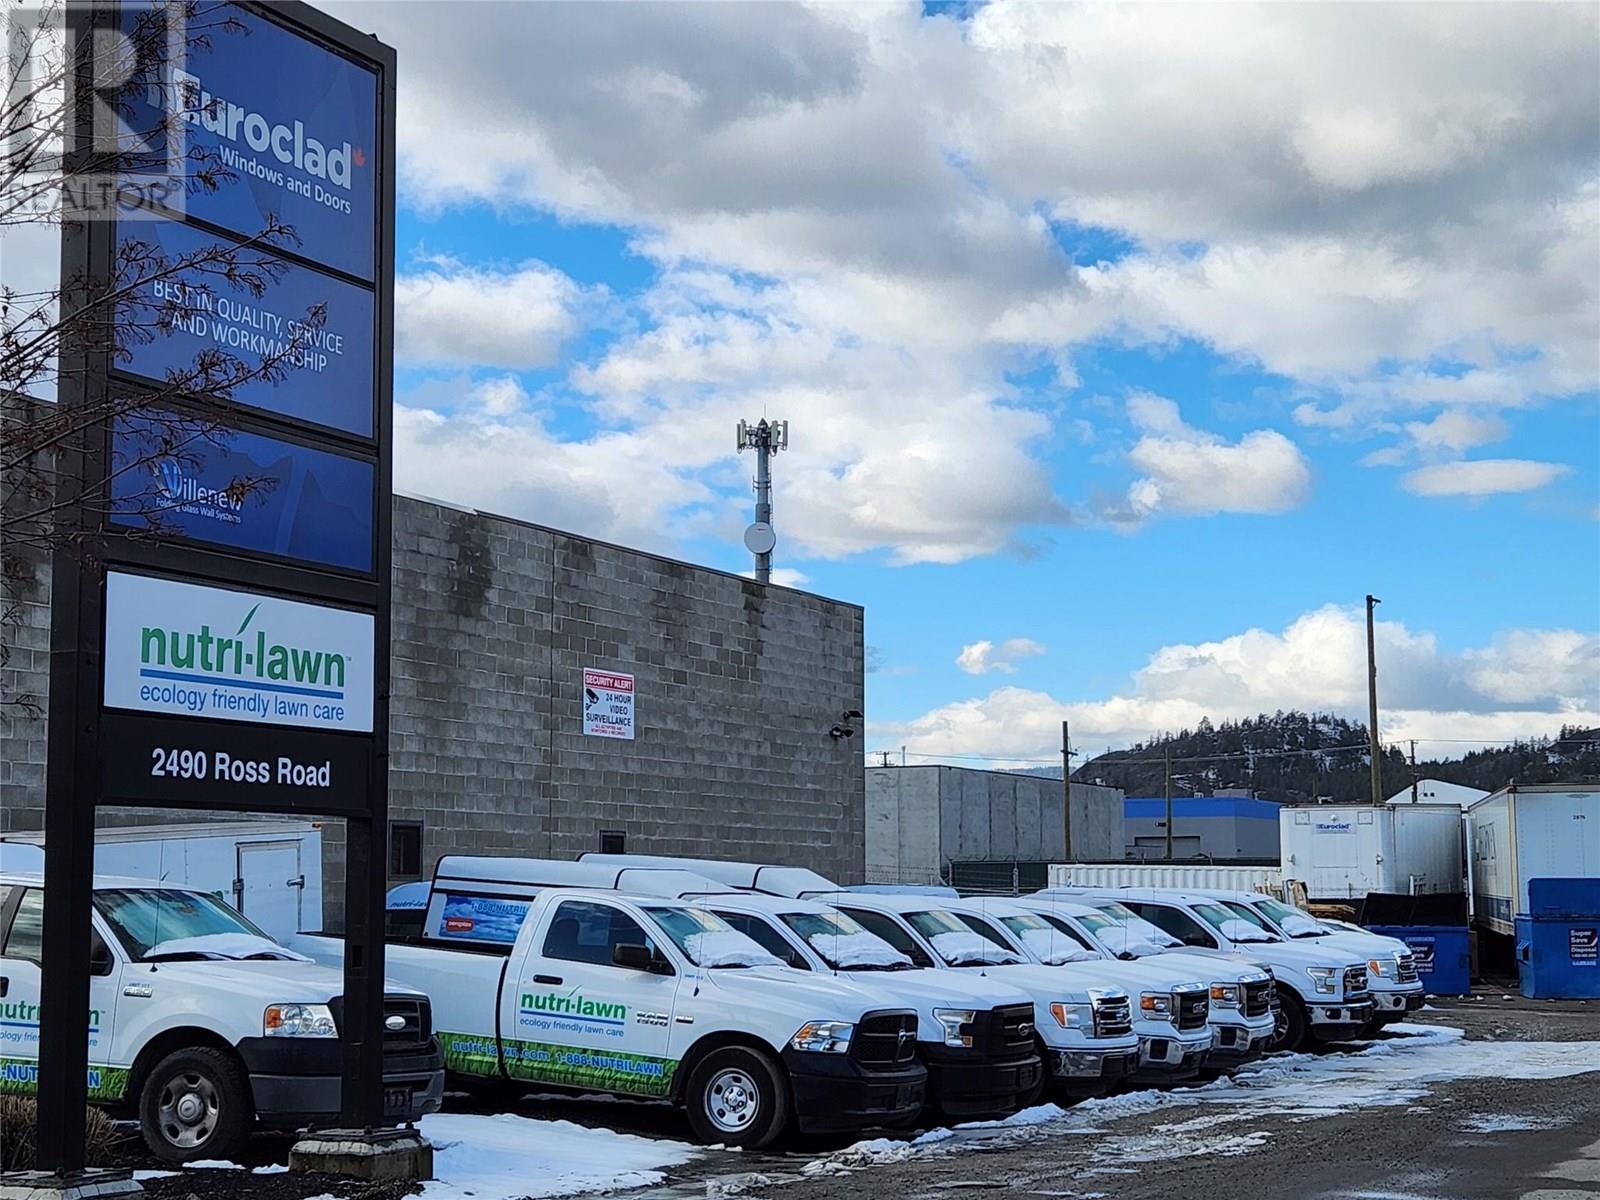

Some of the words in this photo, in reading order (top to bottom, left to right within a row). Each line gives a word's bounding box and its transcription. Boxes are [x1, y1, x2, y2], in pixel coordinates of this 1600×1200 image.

[173, 68, 351, 190] Euroclad
[219, 144, 284, 187] Windows
[286, 177, 311, 198] and
[314, 184, 351, 214] Doors
[153, 279, 194, 307] BEST
[196, 292, 212, 311] IN
[217, 298, 283, 339] QUALITY,
[171, 311, 207, 336] AND
[212, 320, 327, 373] WORKMANSHIP
[200, 506, 215, 518] Wall
[585, 675, 614, 687] SECURITY
[614, 680, 632, 690] ALERT
[140, 683, 207, 711] ecology
[212, 690, 269, 718] friendly
[274, 696, 308, 717] lawn
[313, 703, 344, 721] care
[605, 693, 613, 701] 24
[614, 694, 632, 704] HOUR
[609, 704, 628, 715] VIDEO
[585, 712, 632, 727] SURVEILLANCE
[151, 747, 207, 779] 2490
[215, 752, 270, 783] Ross
[277, 757, 330, 787] Road
[519, 1017, 551, 1030] ecology
[553, 1020, 583, 1034] friendly
[585, 1024, 604, 1035] lawn
[606, 1028, 624, 1037] care
